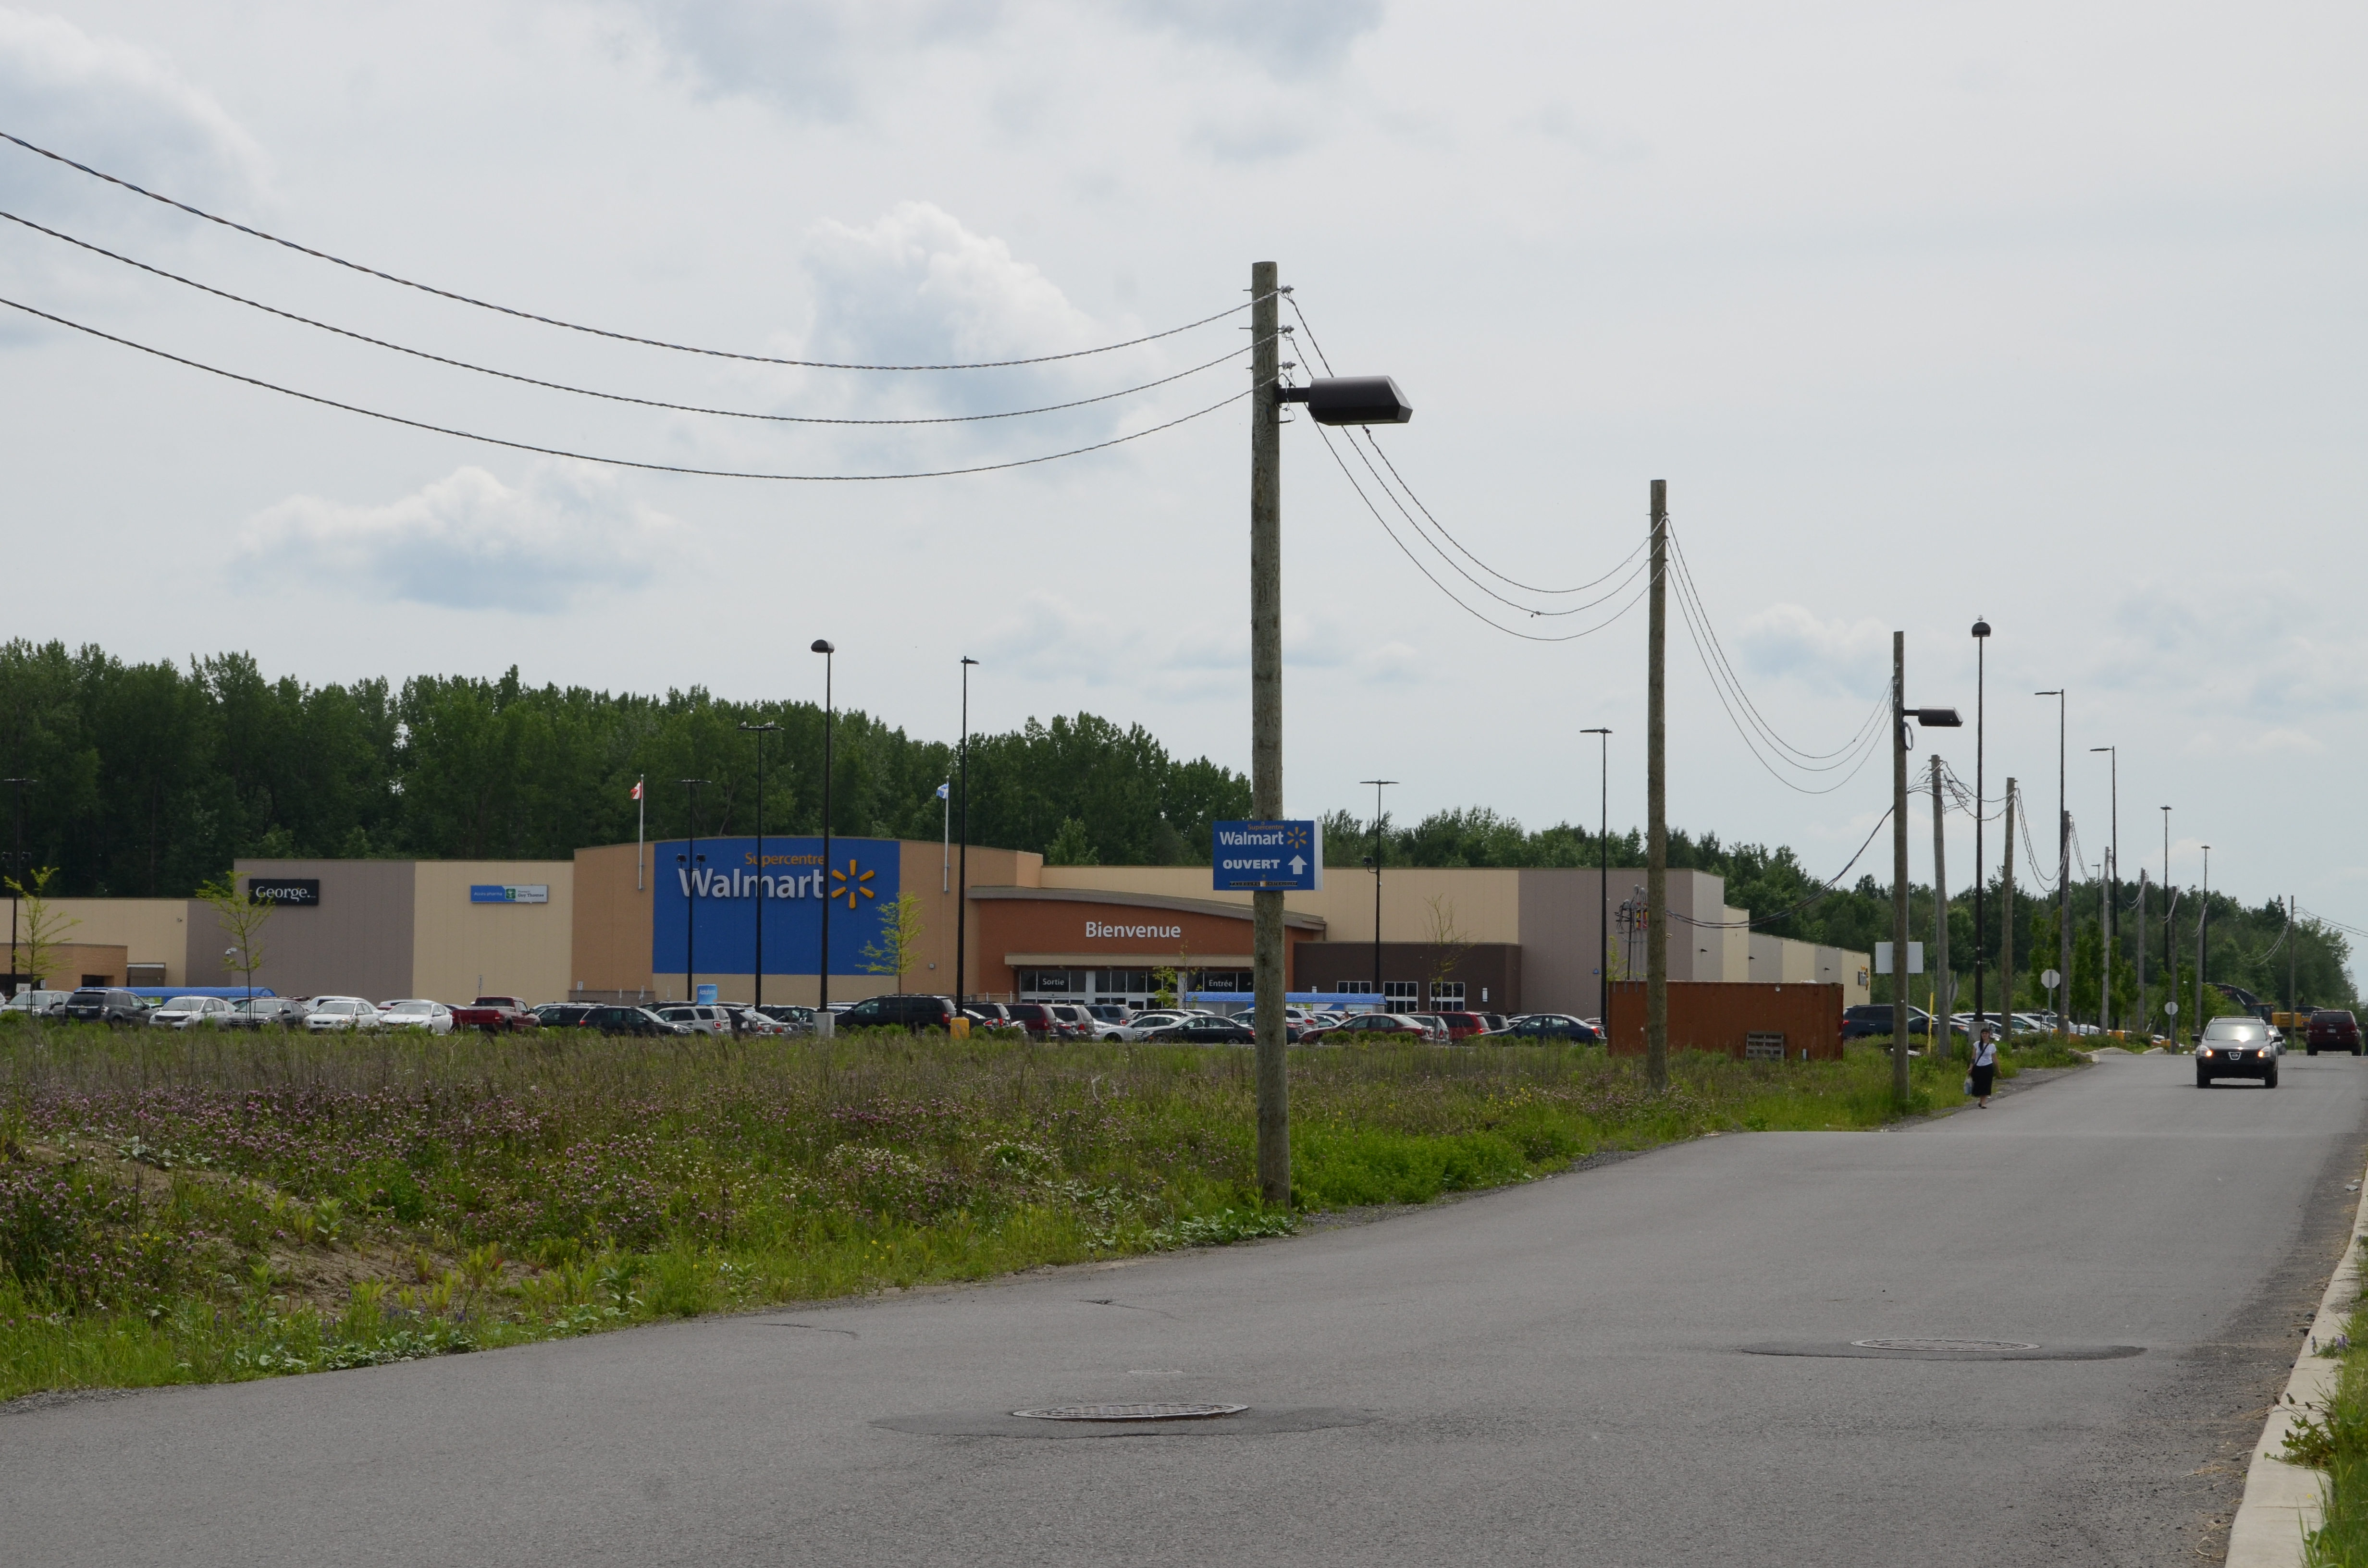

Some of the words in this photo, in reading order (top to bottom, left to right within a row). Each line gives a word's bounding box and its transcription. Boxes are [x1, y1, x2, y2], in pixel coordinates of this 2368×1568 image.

[1219, 831, 1284, 845] Walmart
[745, 852, 824, 868] Supercentre
[1222, 859, 1280, 869] OUVERT
[678, 868, 824, 898] Walmart
[1085, 921, 1181, 938] Bienvenue
